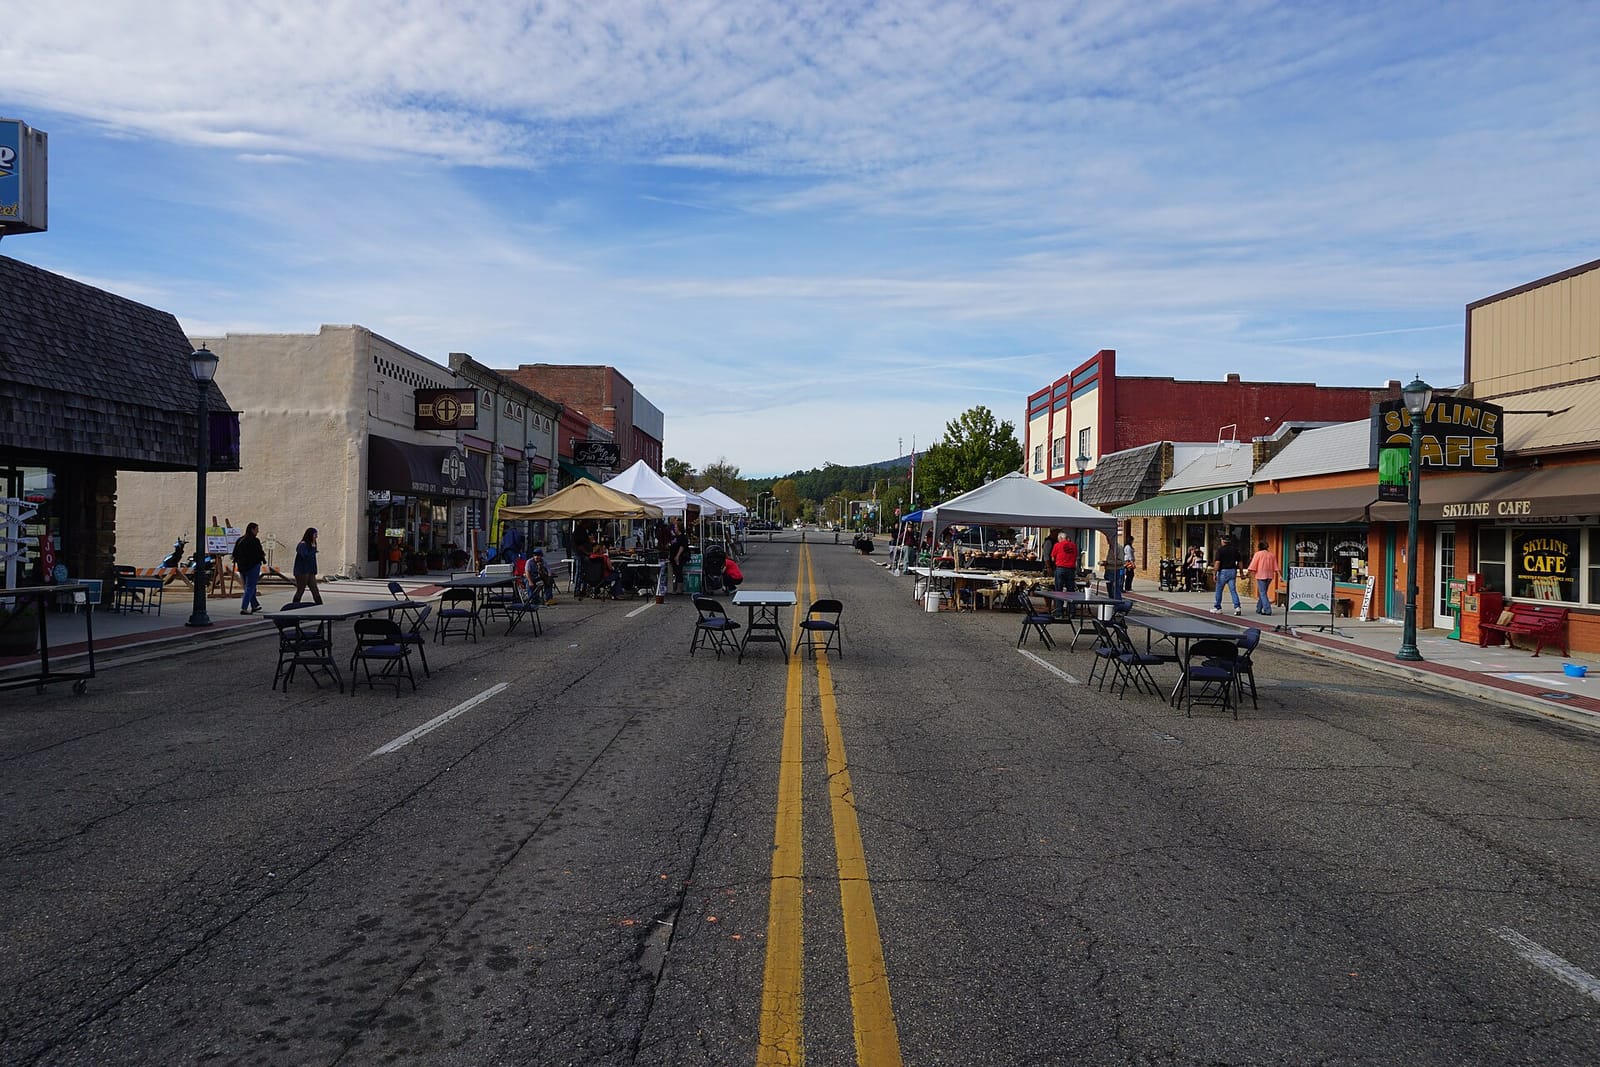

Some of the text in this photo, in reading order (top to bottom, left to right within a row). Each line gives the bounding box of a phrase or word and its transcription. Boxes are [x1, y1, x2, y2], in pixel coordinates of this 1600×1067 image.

[1386, 433, 1499, 467] AFE
[1442, 501, 1532, 518] SKYLINE CAFE
[1523, 538, 1569, 557] SKYLINE
[45, 542, 55, 577] JOY
[1523, 555, 1567, 573] CAFE
[1289, 568, 1332, 581] BREAKFAST
[1291, 592, 1330, 600] Skyline Cafe
[1360, 576, 1374, 618] OPEN
